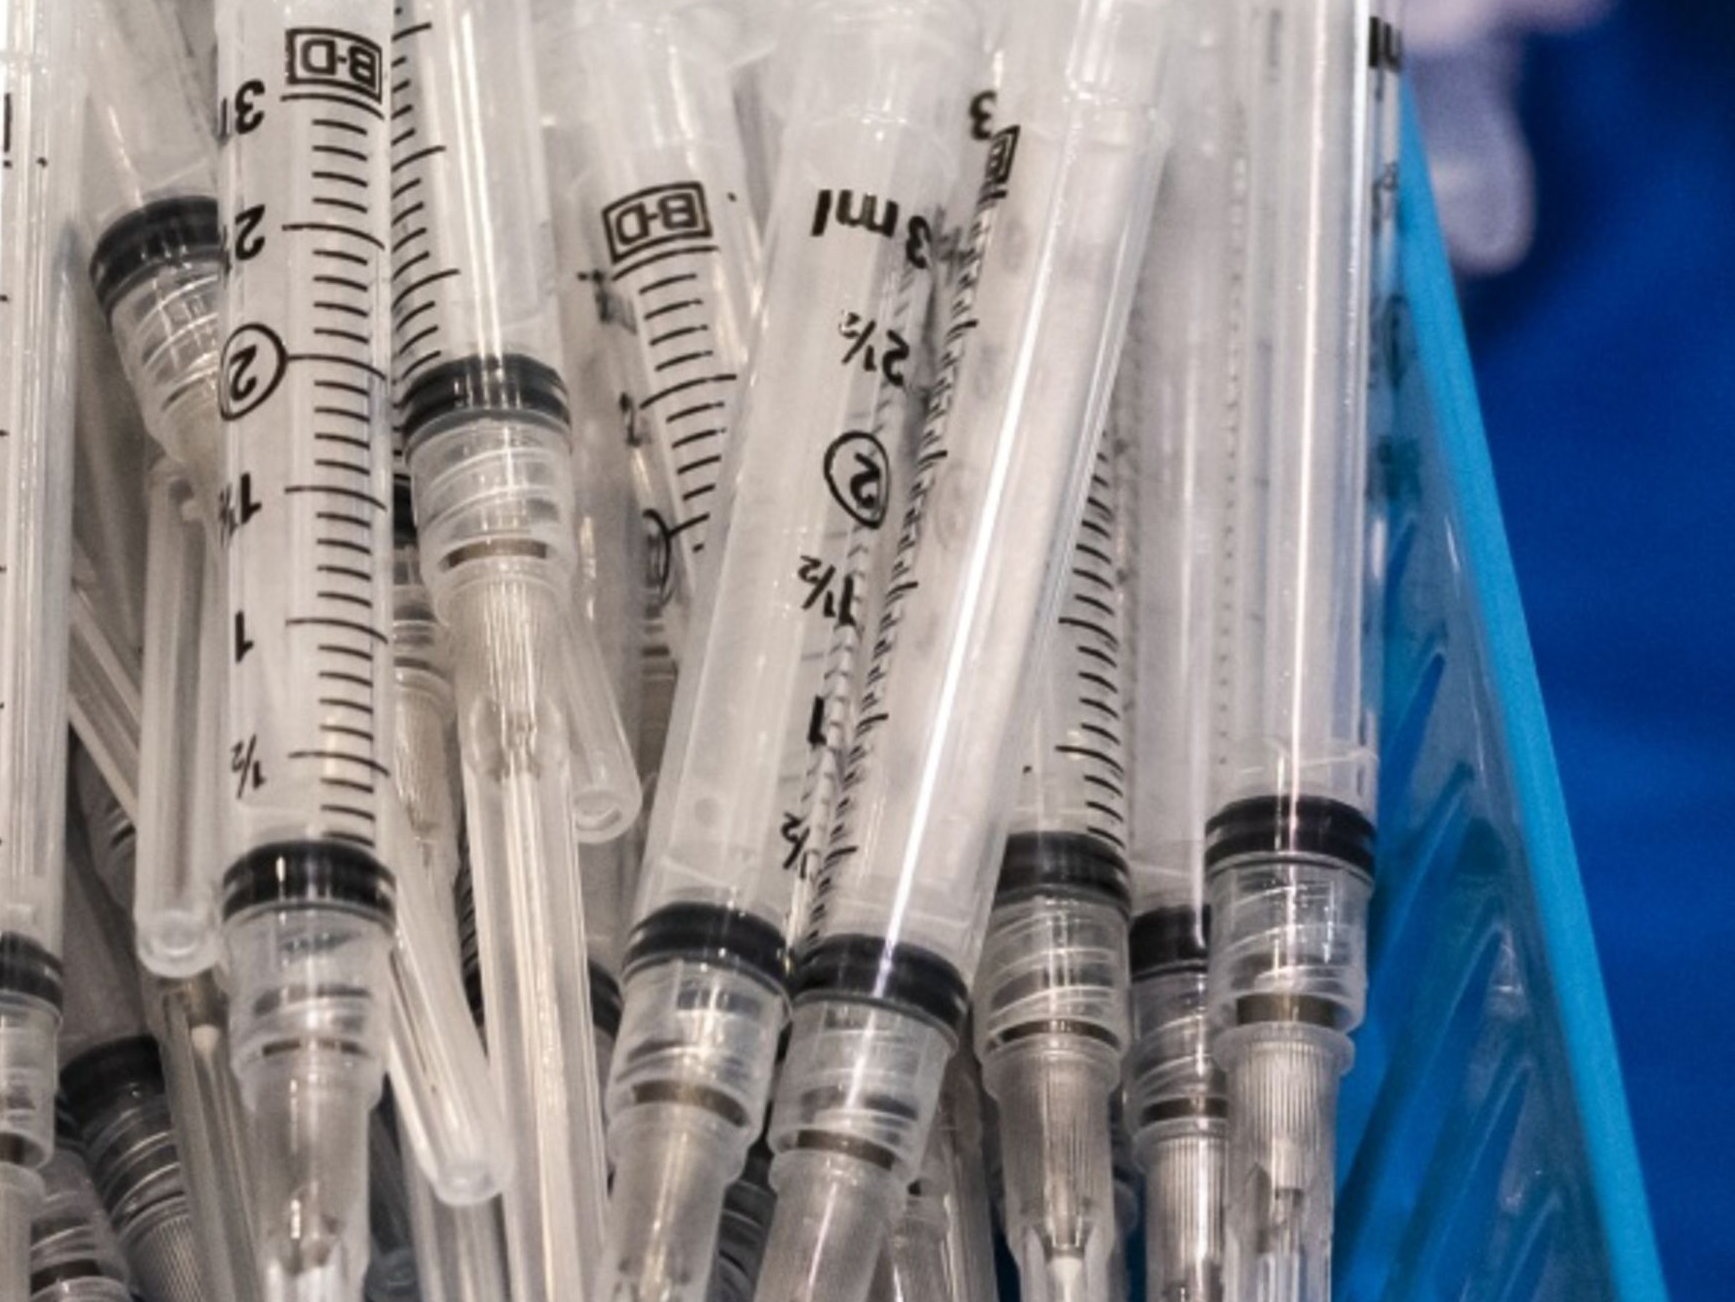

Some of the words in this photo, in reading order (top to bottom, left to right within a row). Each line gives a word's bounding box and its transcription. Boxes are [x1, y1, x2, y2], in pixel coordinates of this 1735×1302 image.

[234, 79, 266, 135] 3
[811, 189, 899, 237] ml
[905, 214, 931, 270] 3
[232, 345, 258, 399] 2
[849, 453, 880, 507] 2
